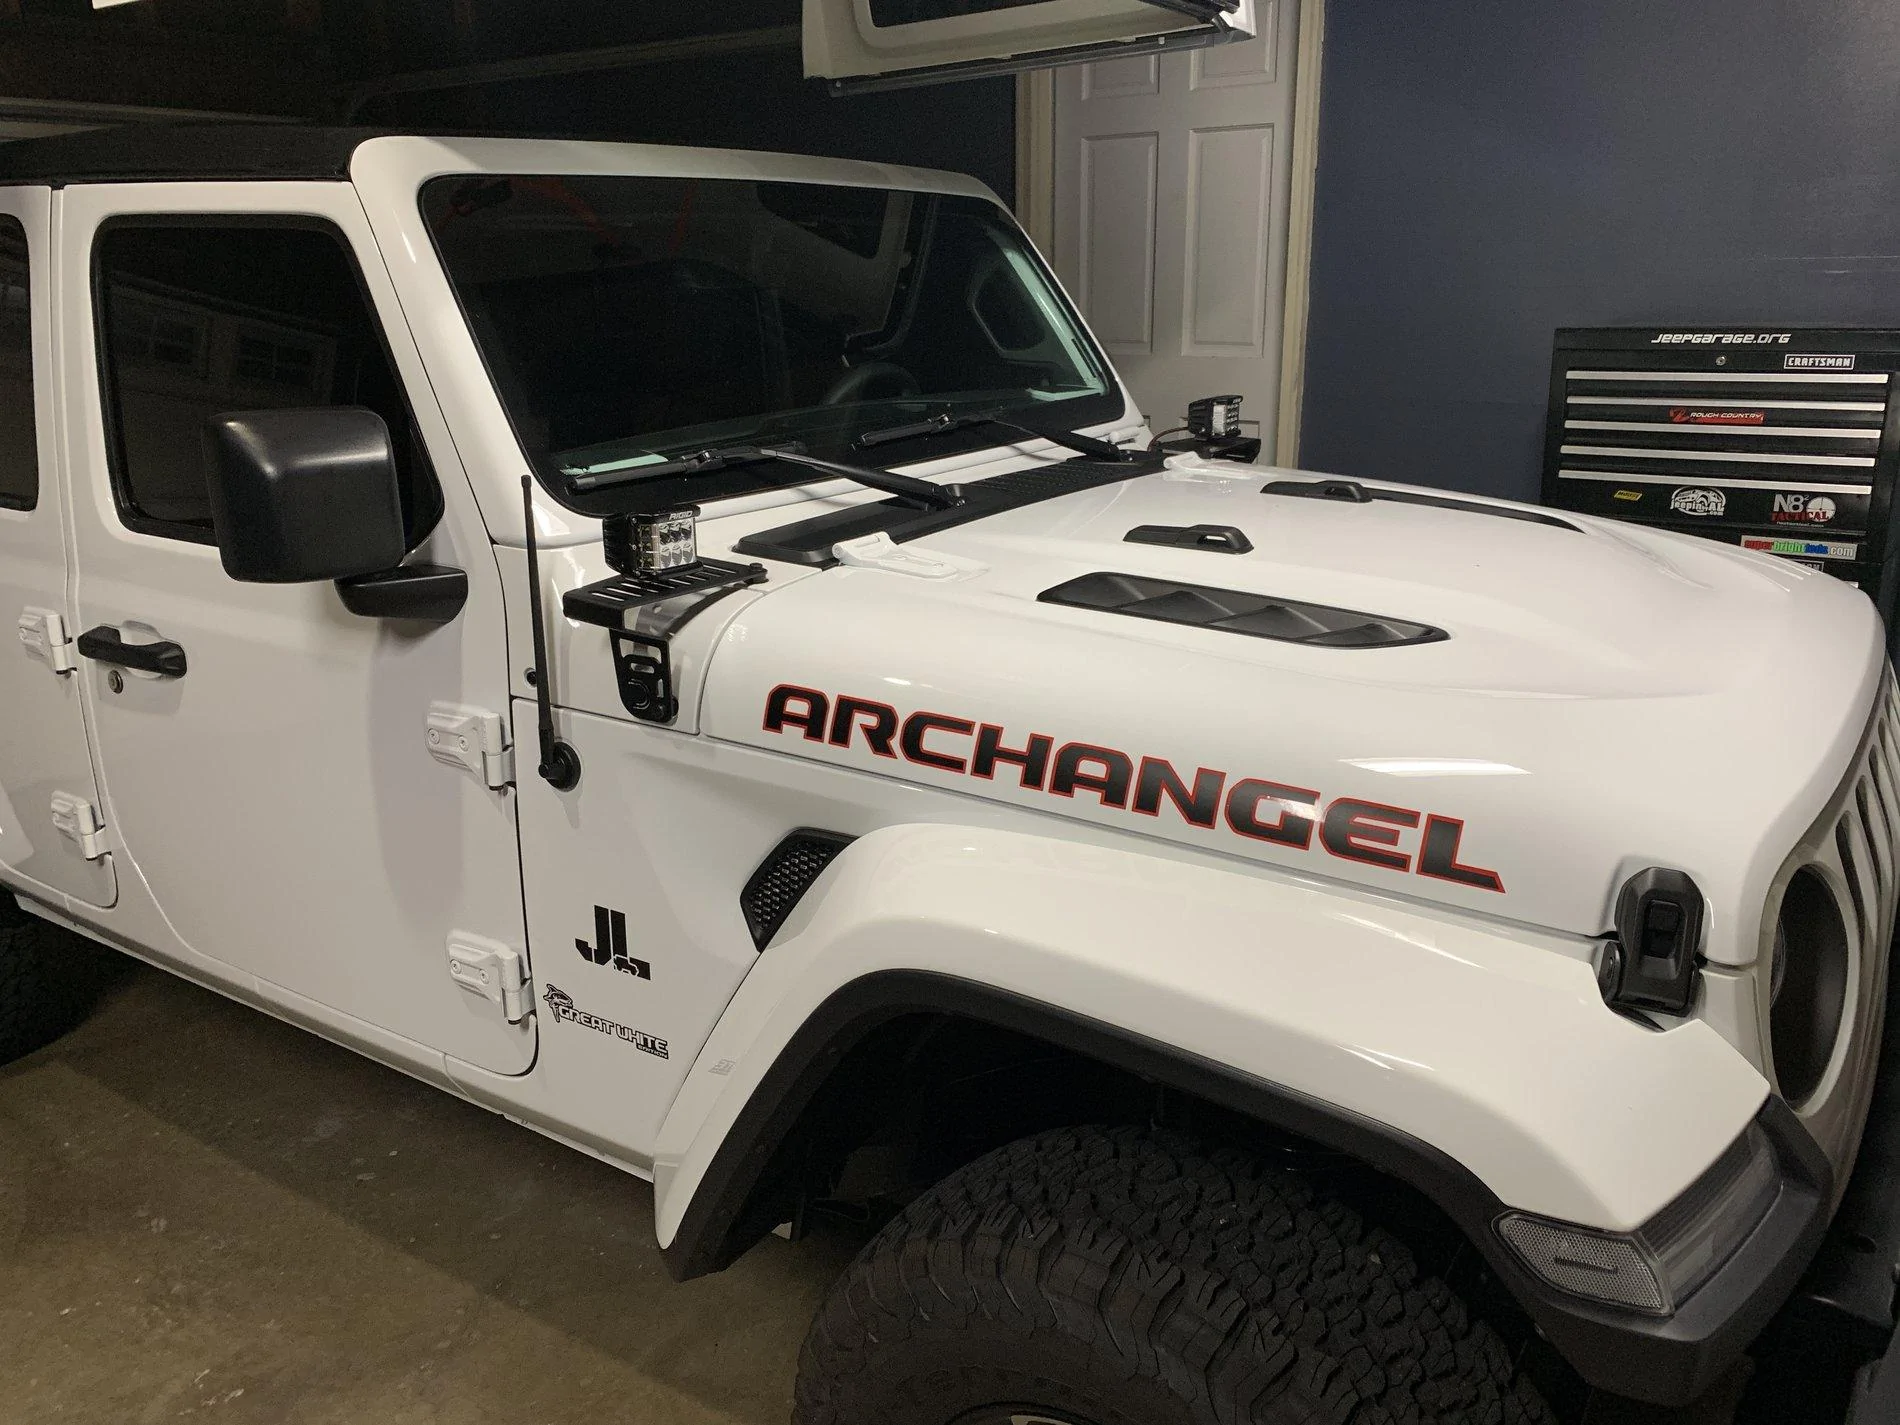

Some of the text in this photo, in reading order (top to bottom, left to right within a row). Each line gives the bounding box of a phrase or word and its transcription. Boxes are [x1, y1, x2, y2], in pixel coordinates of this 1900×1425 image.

[1787, 356, 1851, 367] CRAFTSMAN
[669, 511, 693, 520] RIGID
[1771, 511, 1830, 522] TACTICAL
[762, 684, 1506, 894] ARCHANGEL
[575, 905, 651, 981] JL
[558, 1004, 668, 1054] GREAT WHITE
